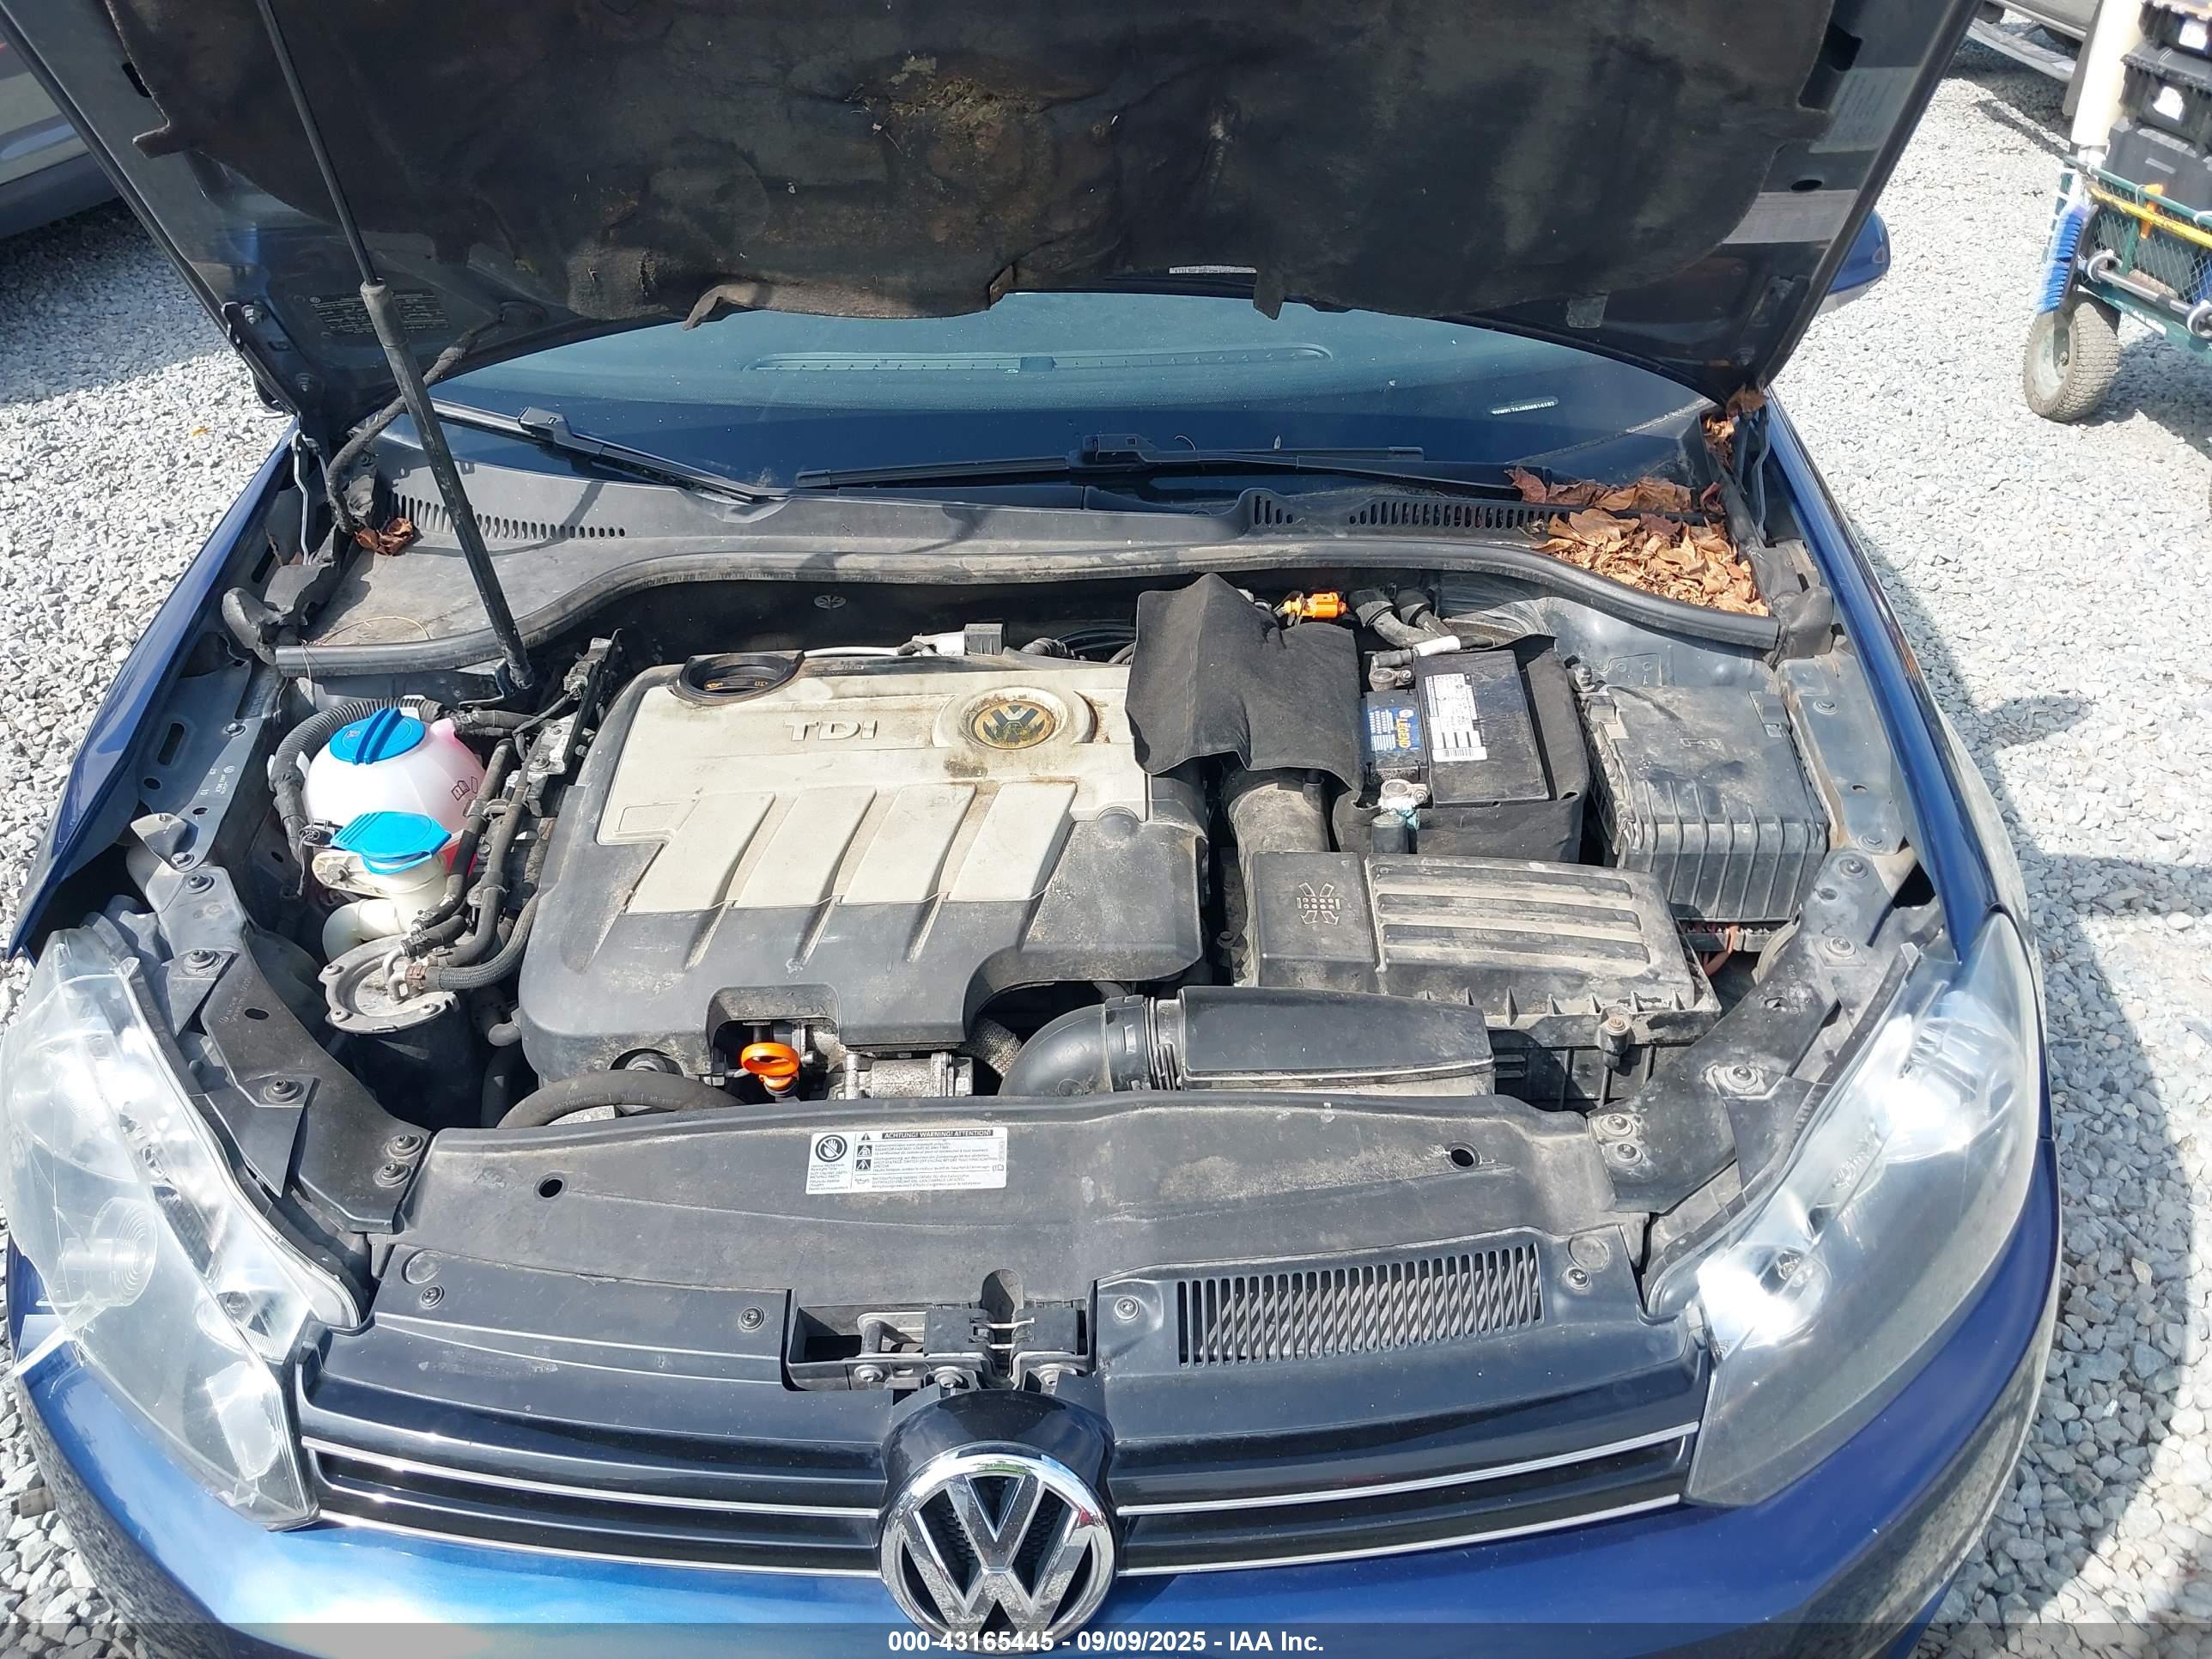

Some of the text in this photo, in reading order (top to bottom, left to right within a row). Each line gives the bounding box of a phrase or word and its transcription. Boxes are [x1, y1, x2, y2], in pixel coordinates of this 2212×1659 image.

[783, 719, 878, 742] TDI
[1397, 717, 1411, 748] LEGEND
[919, 1130, 953, 1139] WARNING!
[954, 1129, 992, 1138] ATTENTION!
